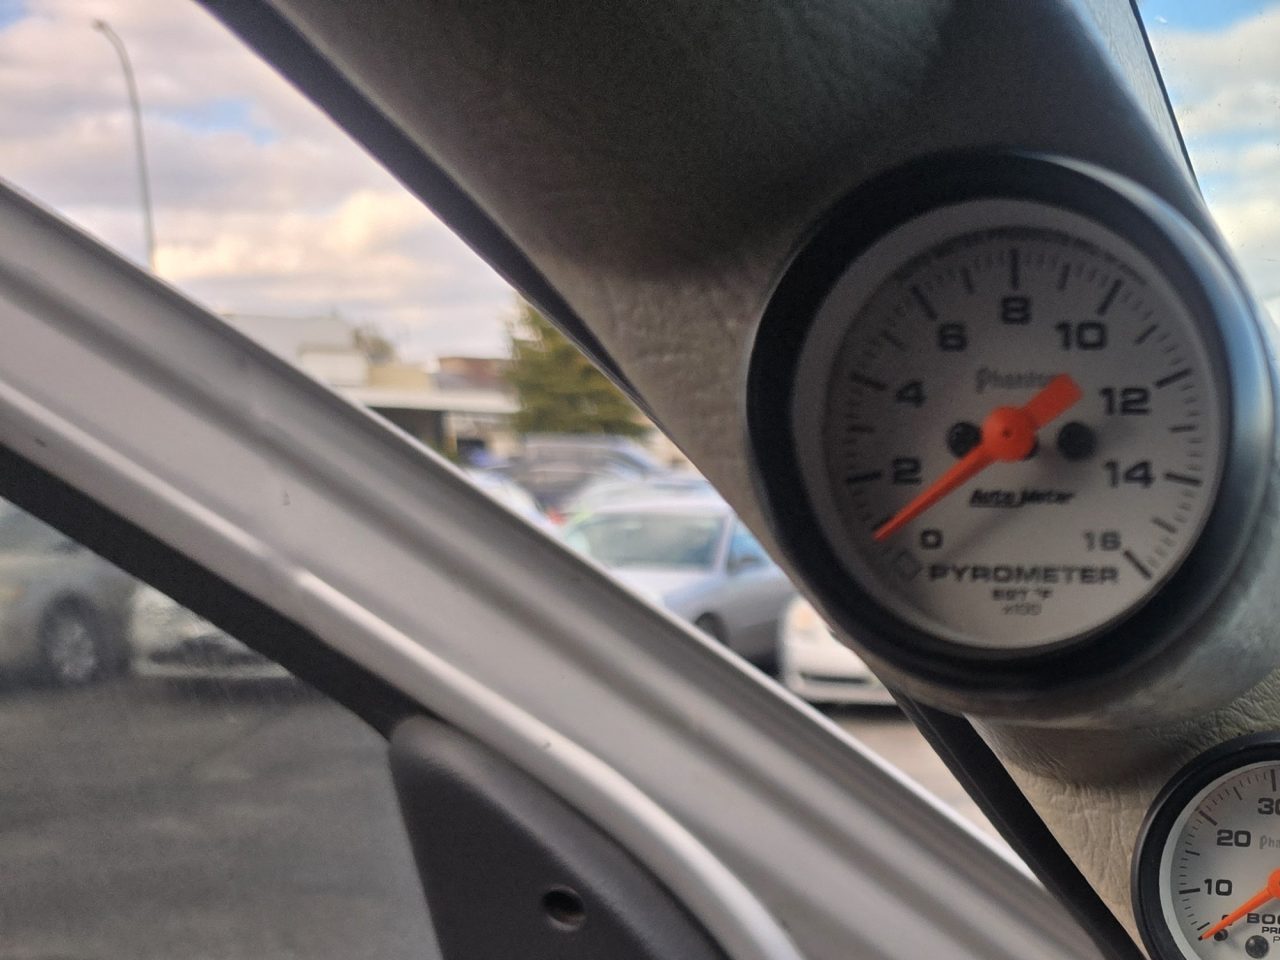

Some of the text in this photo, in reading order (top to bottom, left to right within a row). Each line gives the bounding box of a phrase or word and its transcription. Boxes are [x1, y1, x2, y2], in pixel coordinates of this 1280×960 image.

[1002, 296, 1031, 325] 8
[939, 323, 967, 351] 6
[1057, 322, 1107, 350] 10
[896, 380, 926, 407] 4
[1101, 387, 1150, 416] 12
[893, 457, 922, 485] 2
[1105, 460, 1154, 487] 14
[920, 529, 943, 550] 0
[1083, 531, 1122, 551] 16
[928, 564, 1121, 585] PYROMETER
[1216, 829, 1251, 847] 20
[1204, 878, 1233, 896] 10
